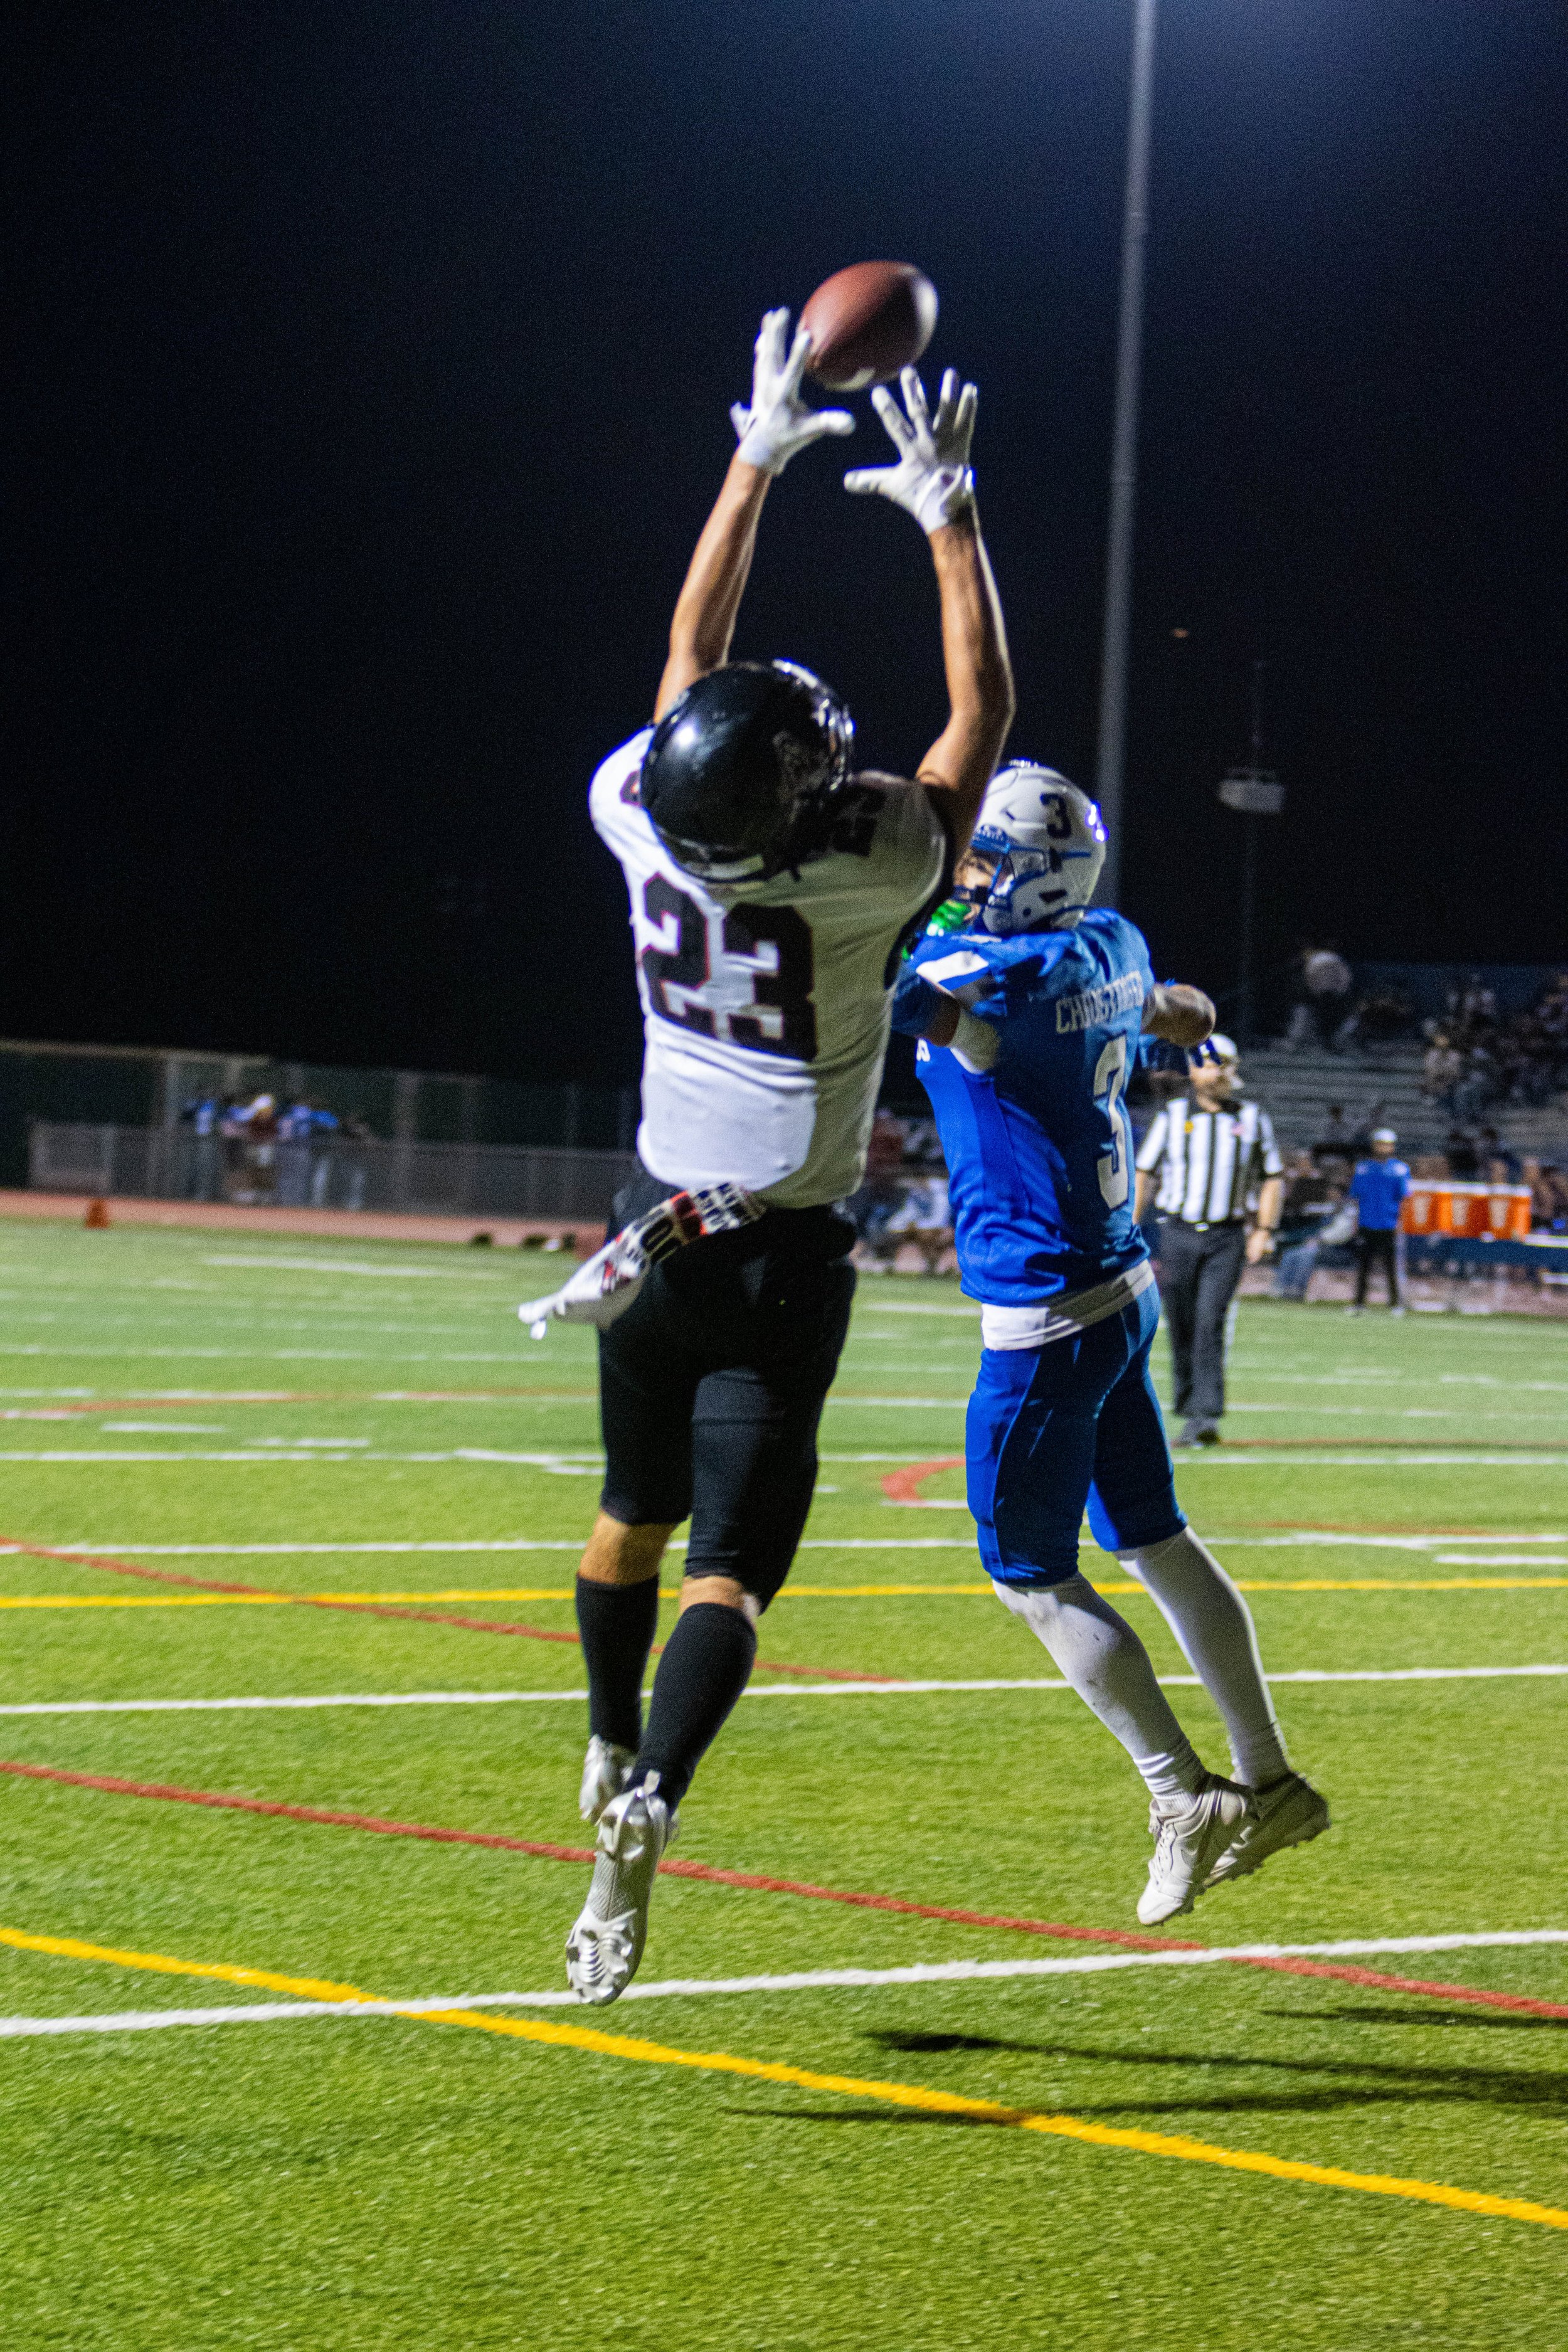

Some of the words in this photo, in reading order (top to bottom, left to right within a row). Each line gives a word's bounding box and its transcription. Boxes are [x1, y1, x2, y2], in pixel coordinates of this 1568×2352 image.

[1039, 792, 1072, 840] 3
[642, 872, 818, 1062] 23
[1093, 1034, 1128, 1210] 3
